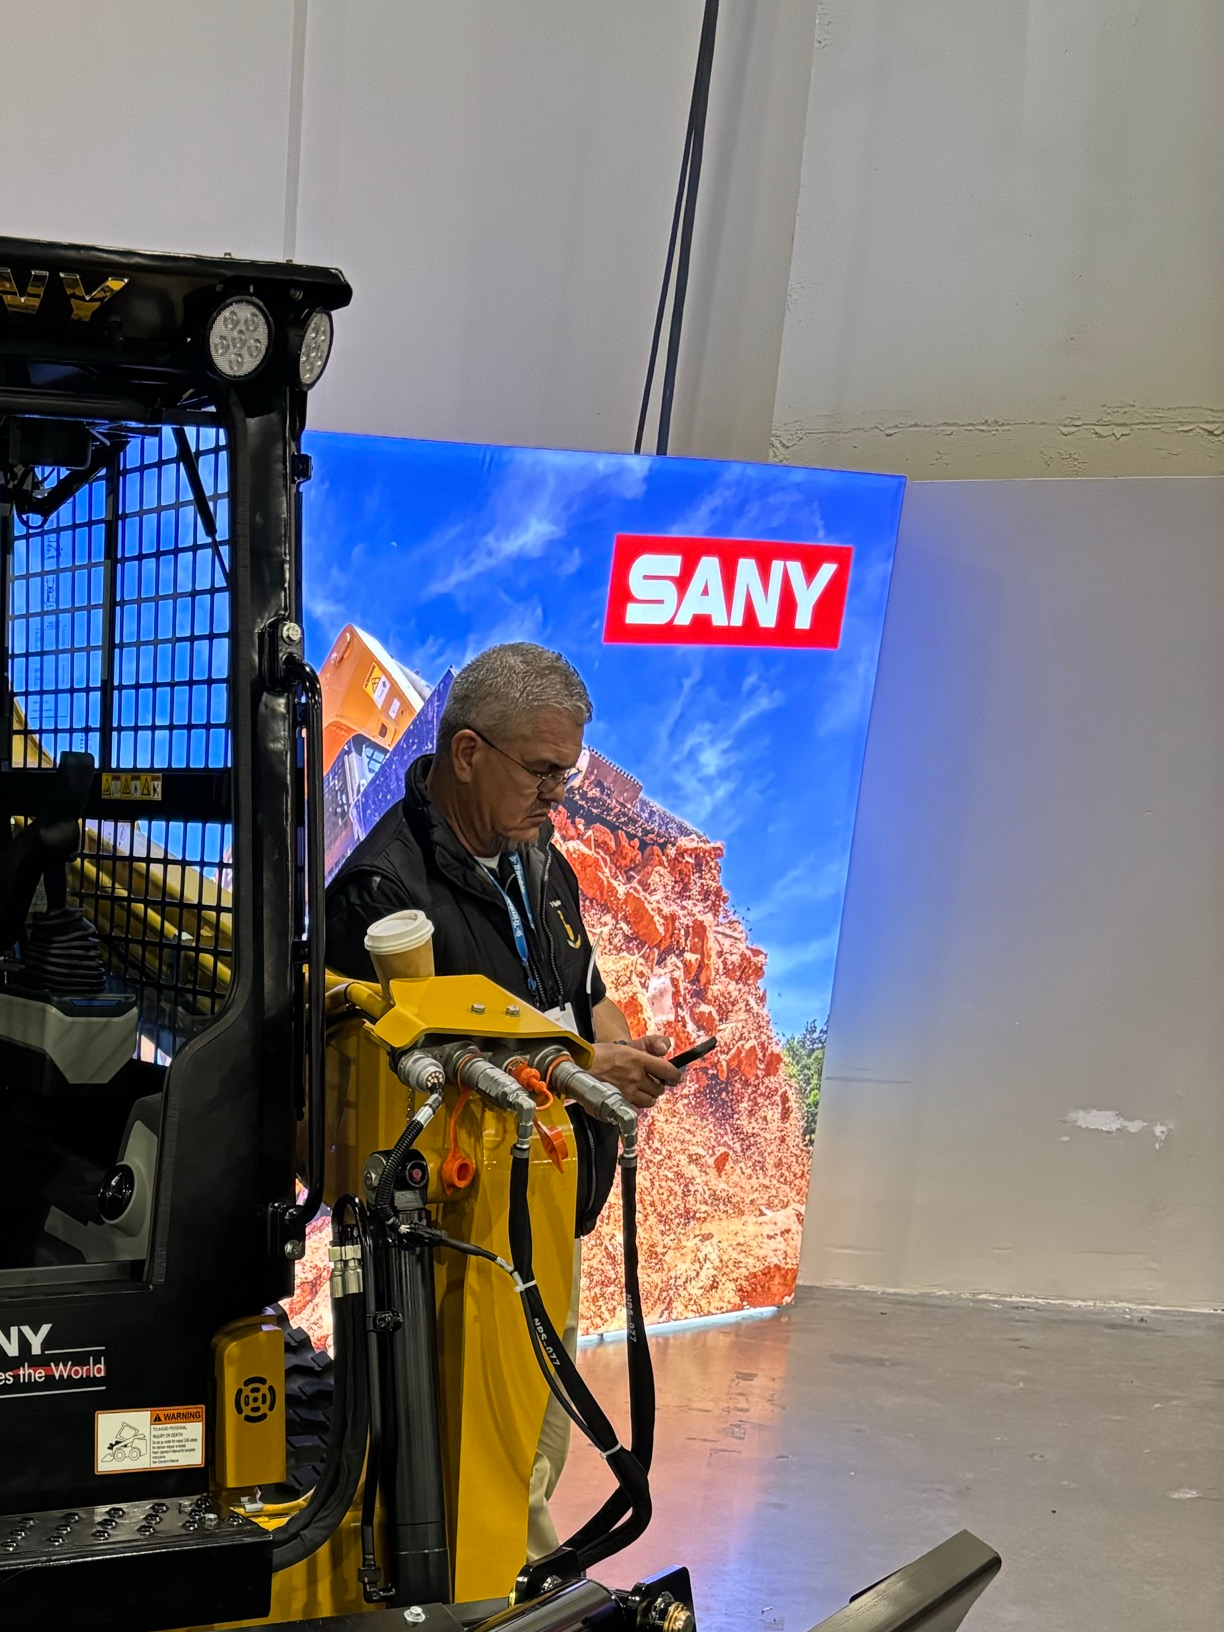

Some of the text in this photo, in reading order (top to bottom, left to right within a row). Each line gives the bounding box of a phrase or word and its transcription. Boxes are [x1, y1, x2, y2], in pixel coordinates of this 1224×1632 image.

[625, 554, 838, 630] SANY
[533, 1317, 561, 1366] NPS-077
[19, 1362, 46, 1383] the
[50, 1356, 105, 1380] World
[163, 1410, 201, 1421] WARNING
